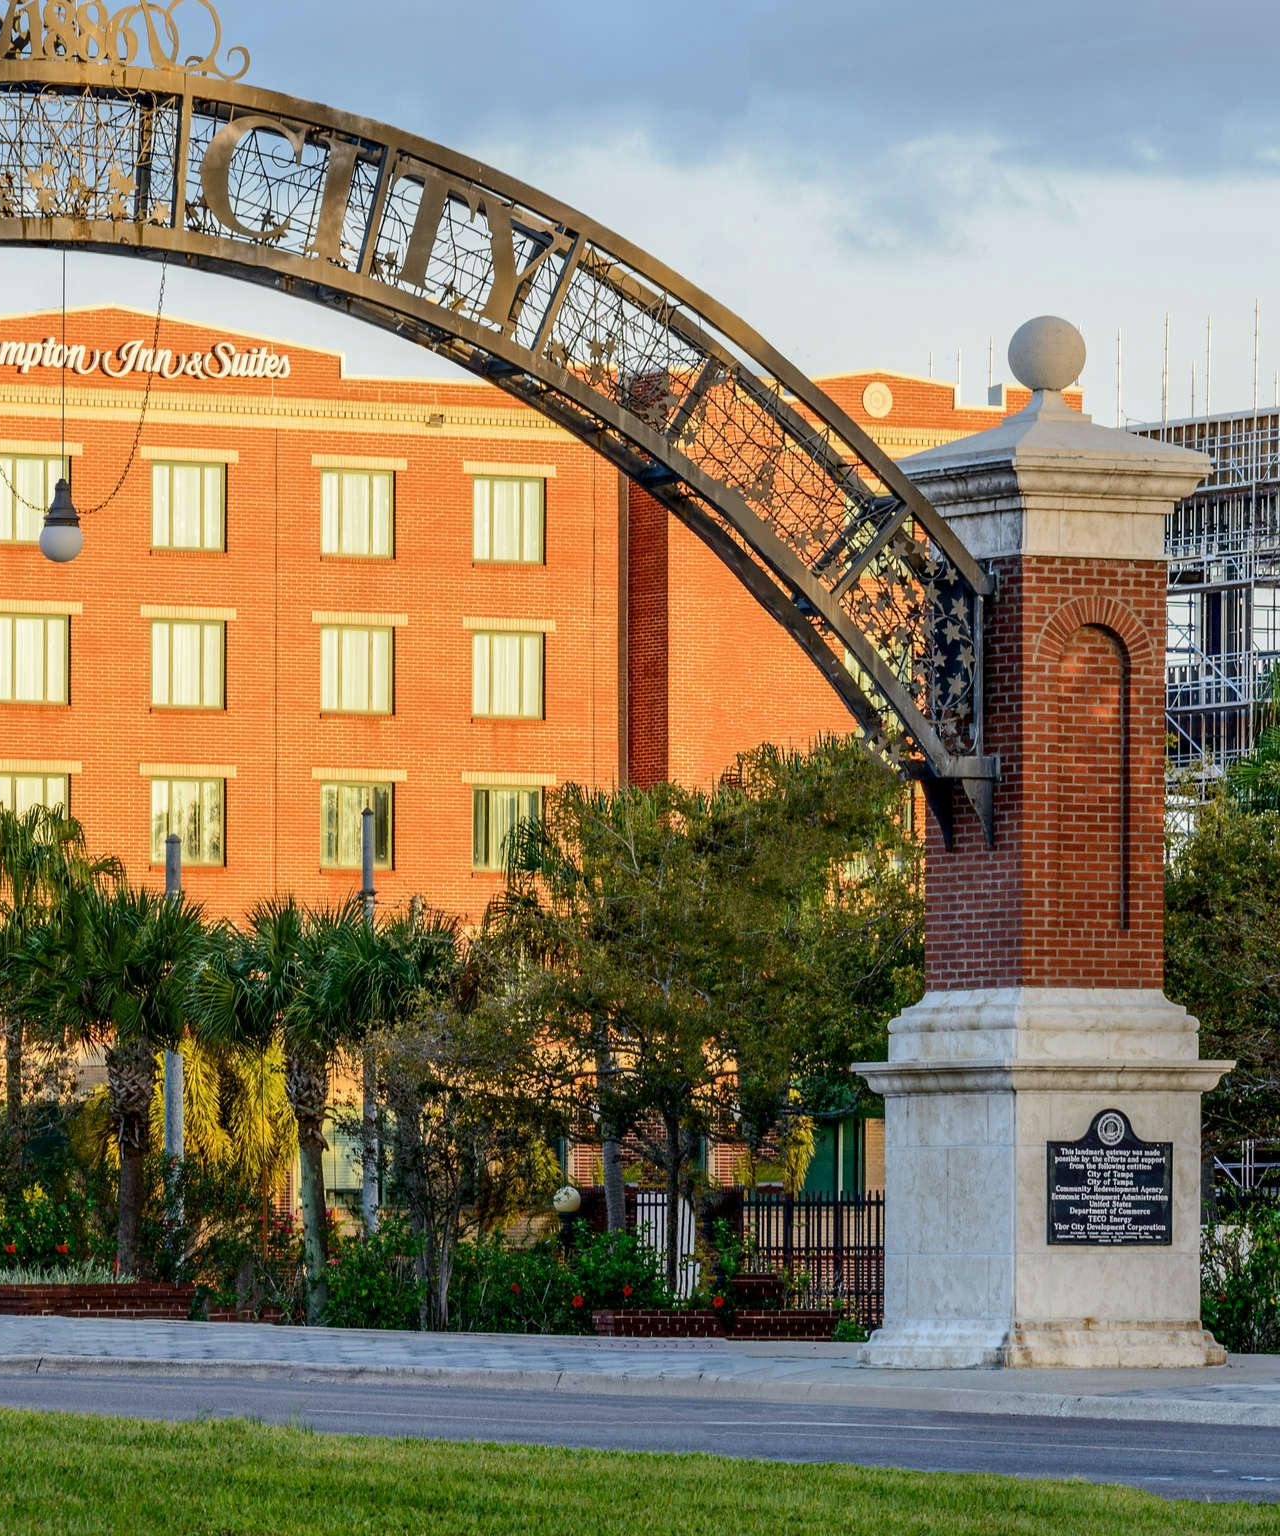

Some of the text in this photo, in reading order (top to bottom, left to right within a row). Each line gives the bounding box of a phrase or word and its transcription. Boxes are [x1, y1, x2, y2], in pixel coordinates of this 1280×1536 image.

[199, 115, 574, 337] CITY
[101, 340, 187, 378] Inn
[186, 352, 207, 380] &
[204, 342, 291, 379] Suites
[1106, 1149, 1131, 1157] gateway
[1055, 1156, 1079, 1164] possible
[1098, 1163, 1125, 1171] following
[1087, 1170, 1101, 1178] City
[1087, 1178, 1101, 1186] City
[1055, 1185, 1163, 1194] Community Redevelopment Agency
[1081, 1193, 1120, 1201] Development
[1069, 1207, 1107, 1216] Department
[1087, 1215, 1132, 1224] TECO Energy
[1054, 1222, 1166, 1231] Ybor City Development Corporation
